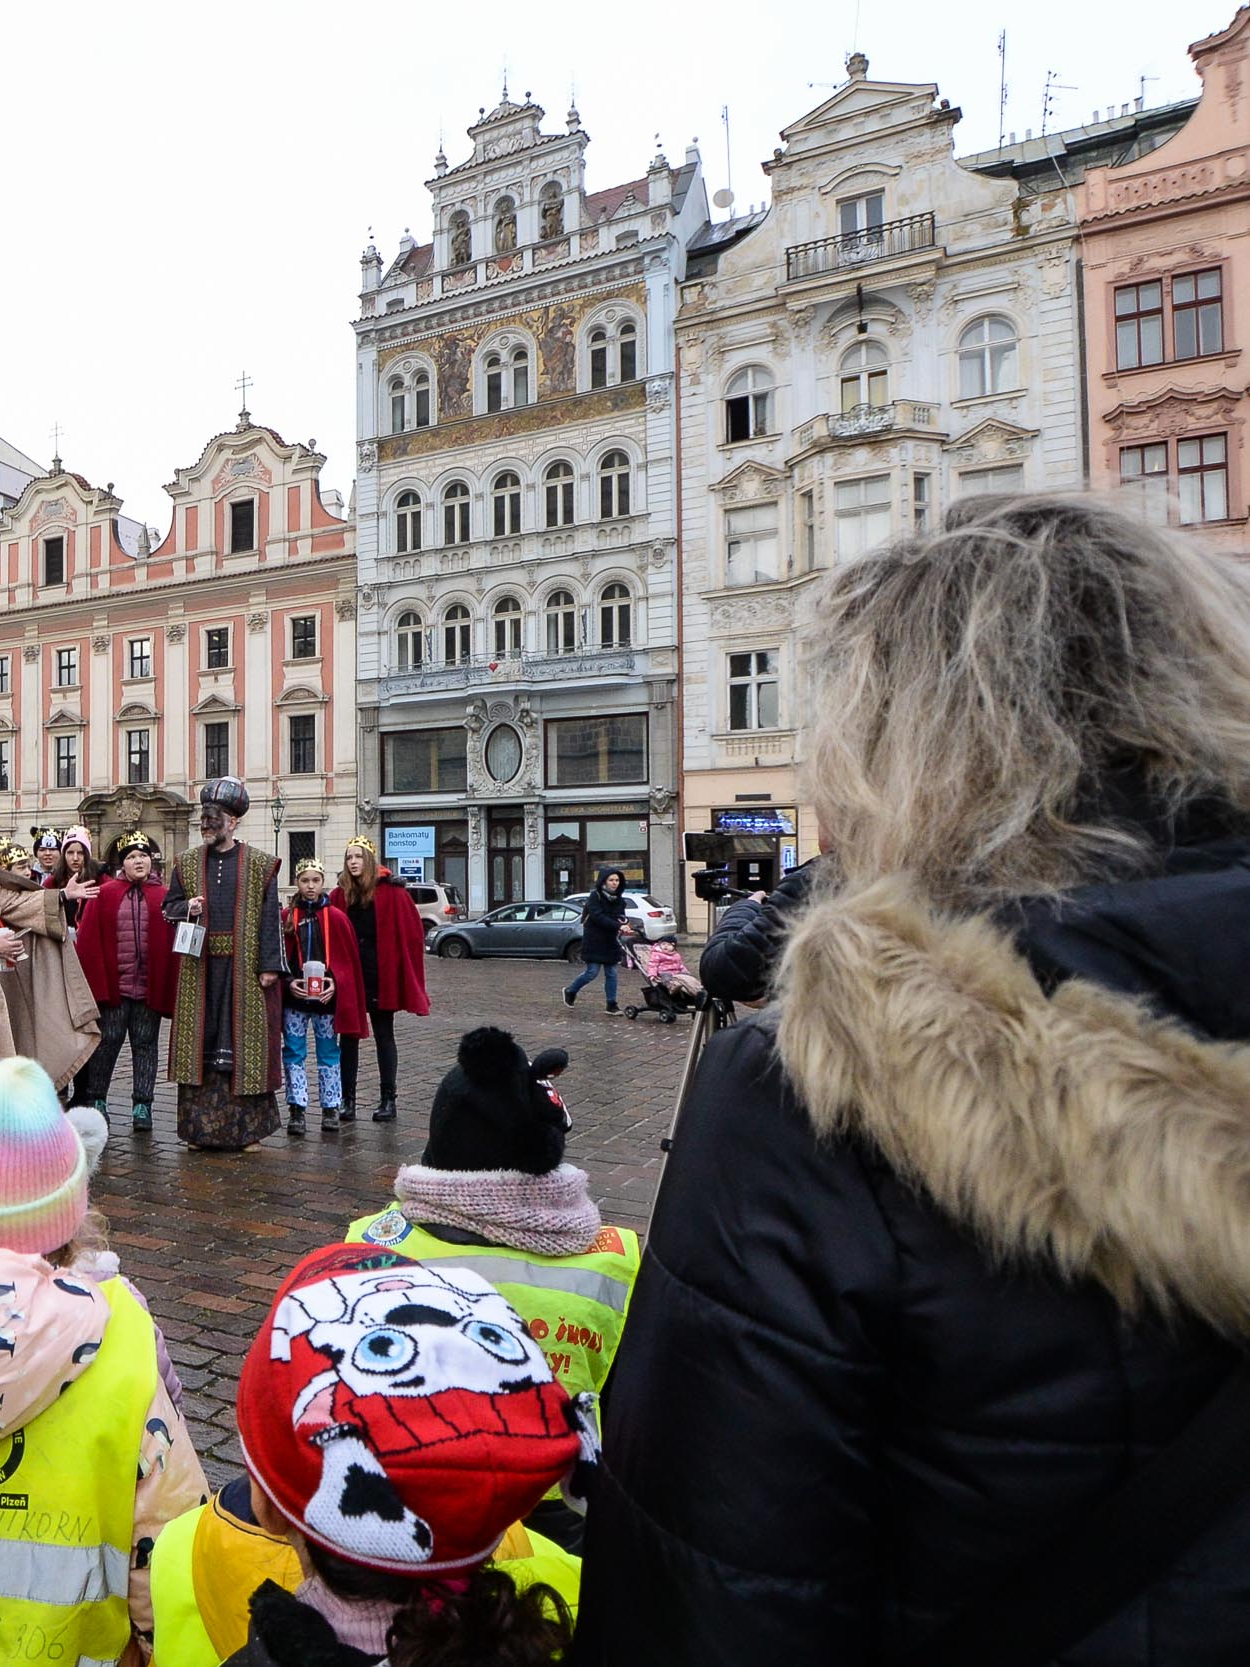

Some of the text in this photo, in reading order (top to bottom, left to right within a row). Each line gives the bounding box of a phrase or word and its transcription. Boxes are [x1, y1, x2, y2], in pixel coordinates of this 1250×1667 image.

[388, 831, 430, 840] Bankomaty
[388, 839, 418, 848] nonstop
[0, 1496, 27, 1507] Plzeň
